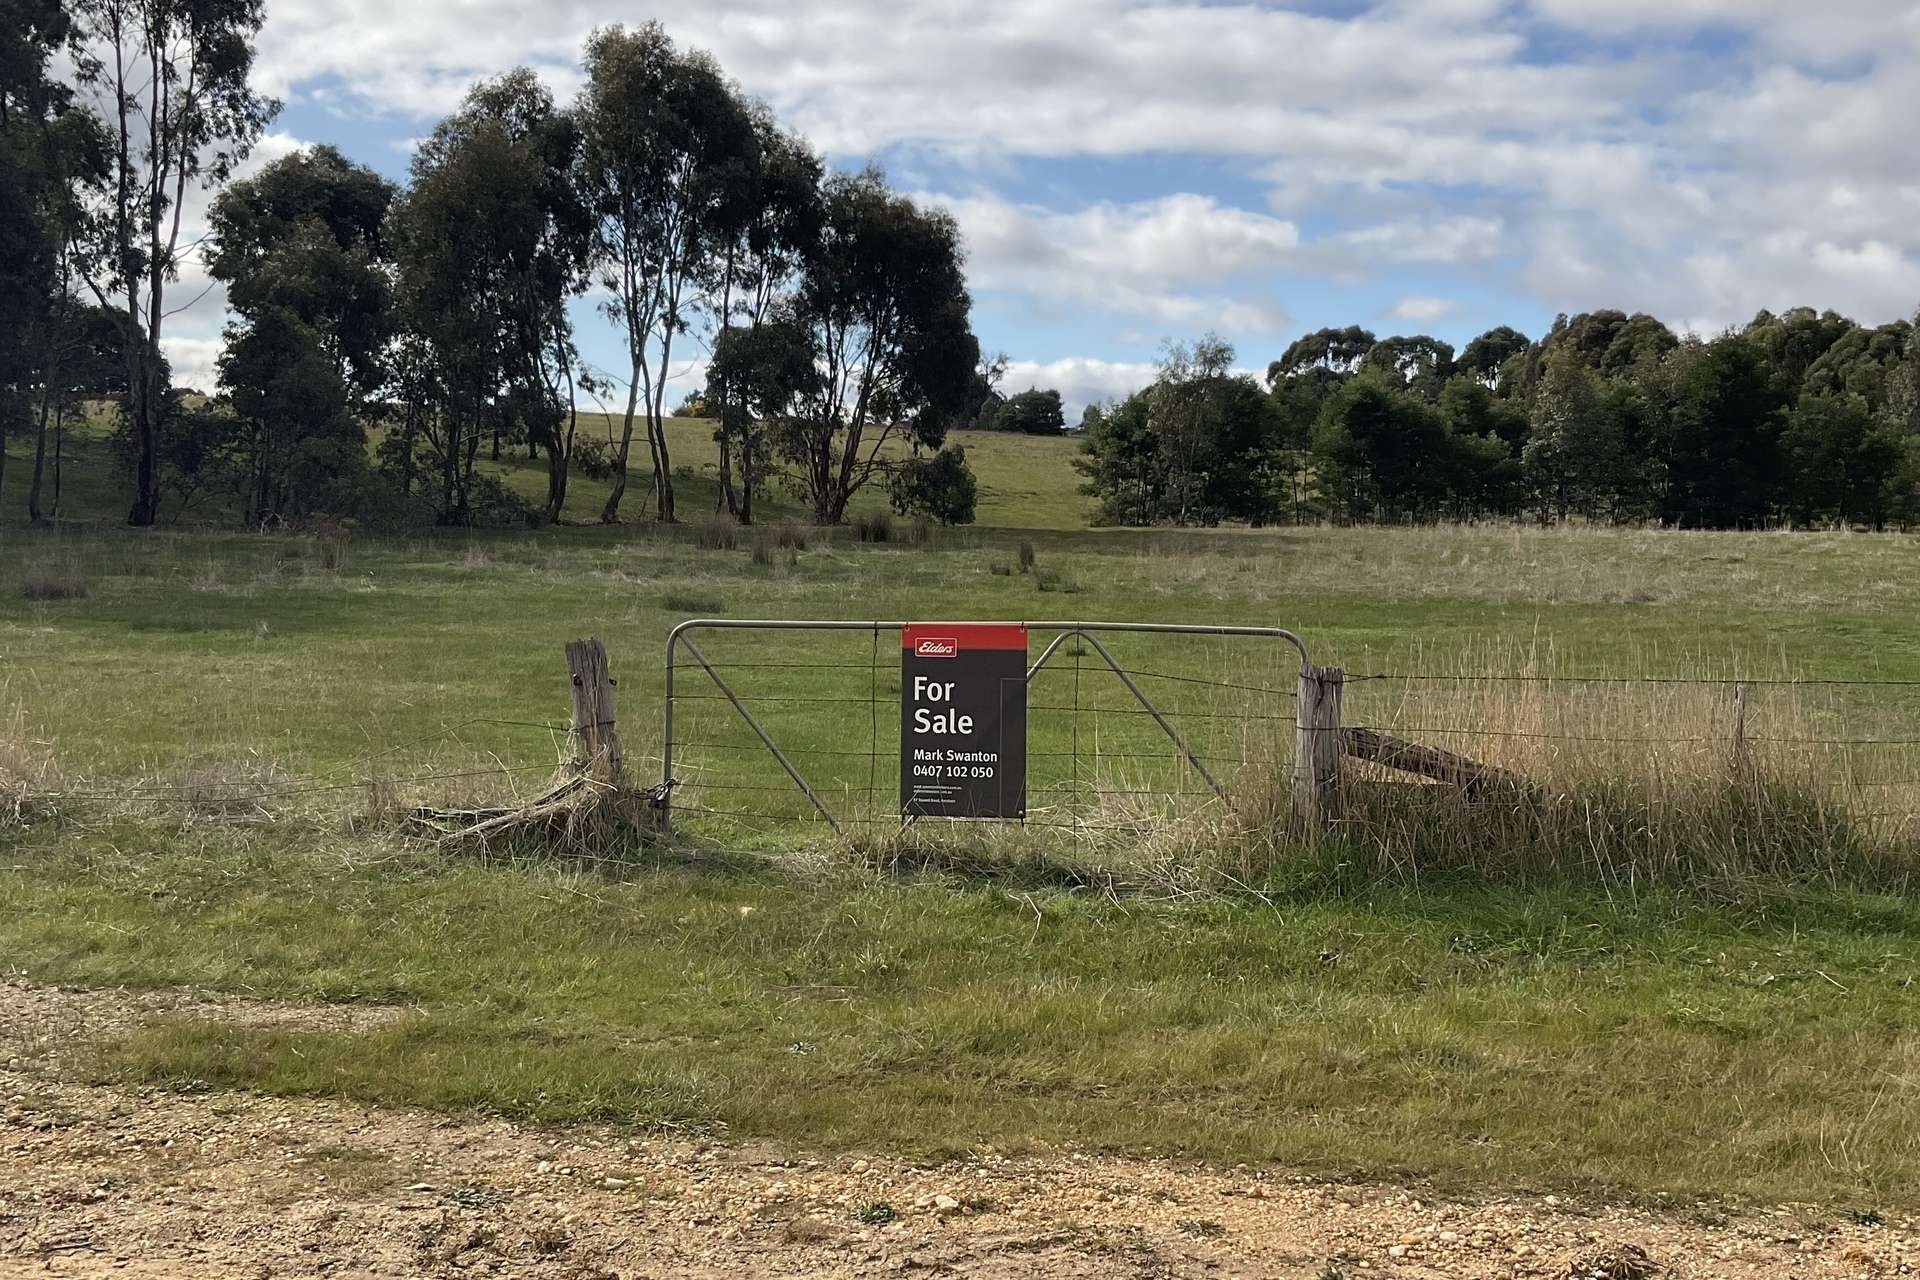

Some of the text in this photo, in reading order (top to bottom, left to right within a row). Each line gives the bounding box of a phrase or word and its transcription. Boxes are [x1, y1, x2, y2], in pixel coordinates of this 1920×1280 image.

[918, 641, 954, 653] Elders
[914, 676, 955, 701] For
[913, 708, 973, 734] Sale
[913, 749, 998, 762] Mark Swanton
[913, 765, 994, 778] 0407 102 050
